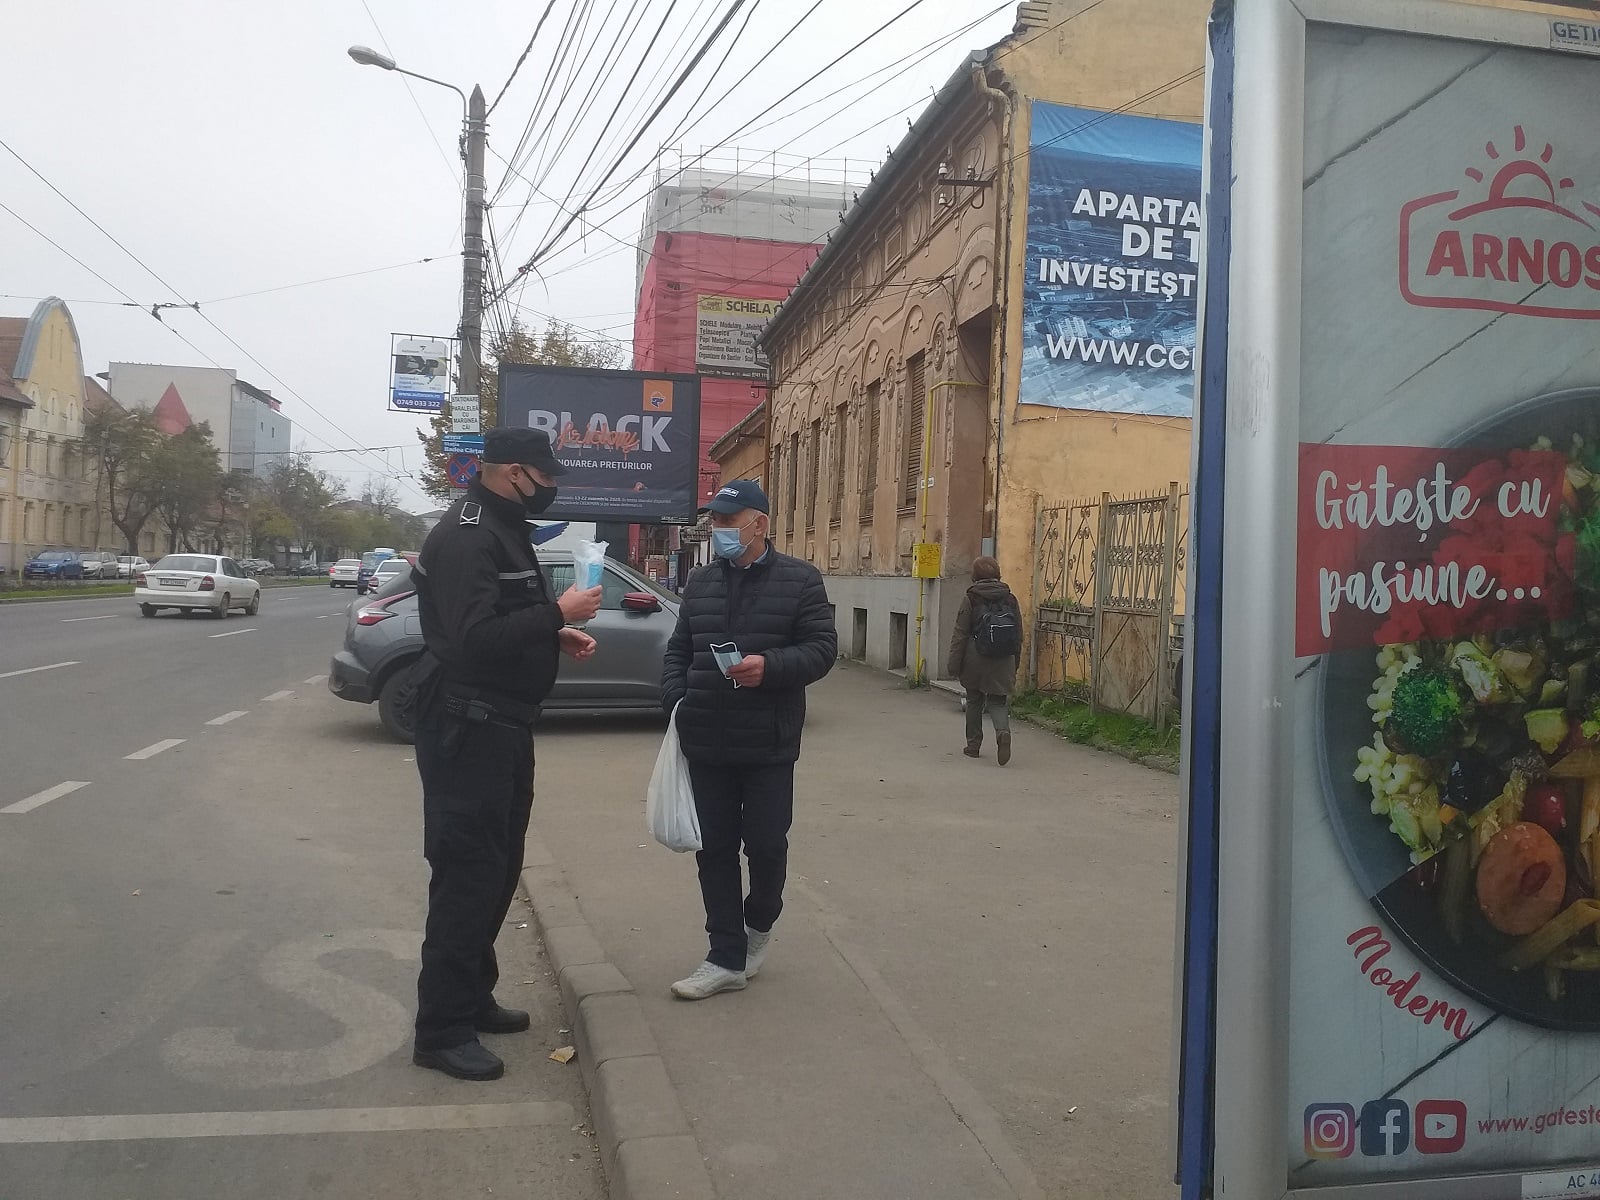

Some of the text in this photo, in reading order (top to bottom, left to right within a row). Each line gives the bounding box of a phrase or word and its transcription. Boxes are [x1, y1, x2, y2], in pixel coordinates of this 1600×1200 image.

[1553, 22, 1600, 41] GETI
[1072, 188, 1200, 228] APARTA
[1122, 223, 1173, 260] DE
[726, 300, 771, 314] SCHELA
[528, 409, 672, 453] BLACK
[1315, 462, 1550, 542] Gătește cu
[1320, 561, 1541, 638] pasiune...
[1347, 926, 1474, 1040] Modern
[1567, 1174, 1586, 1188] AC
